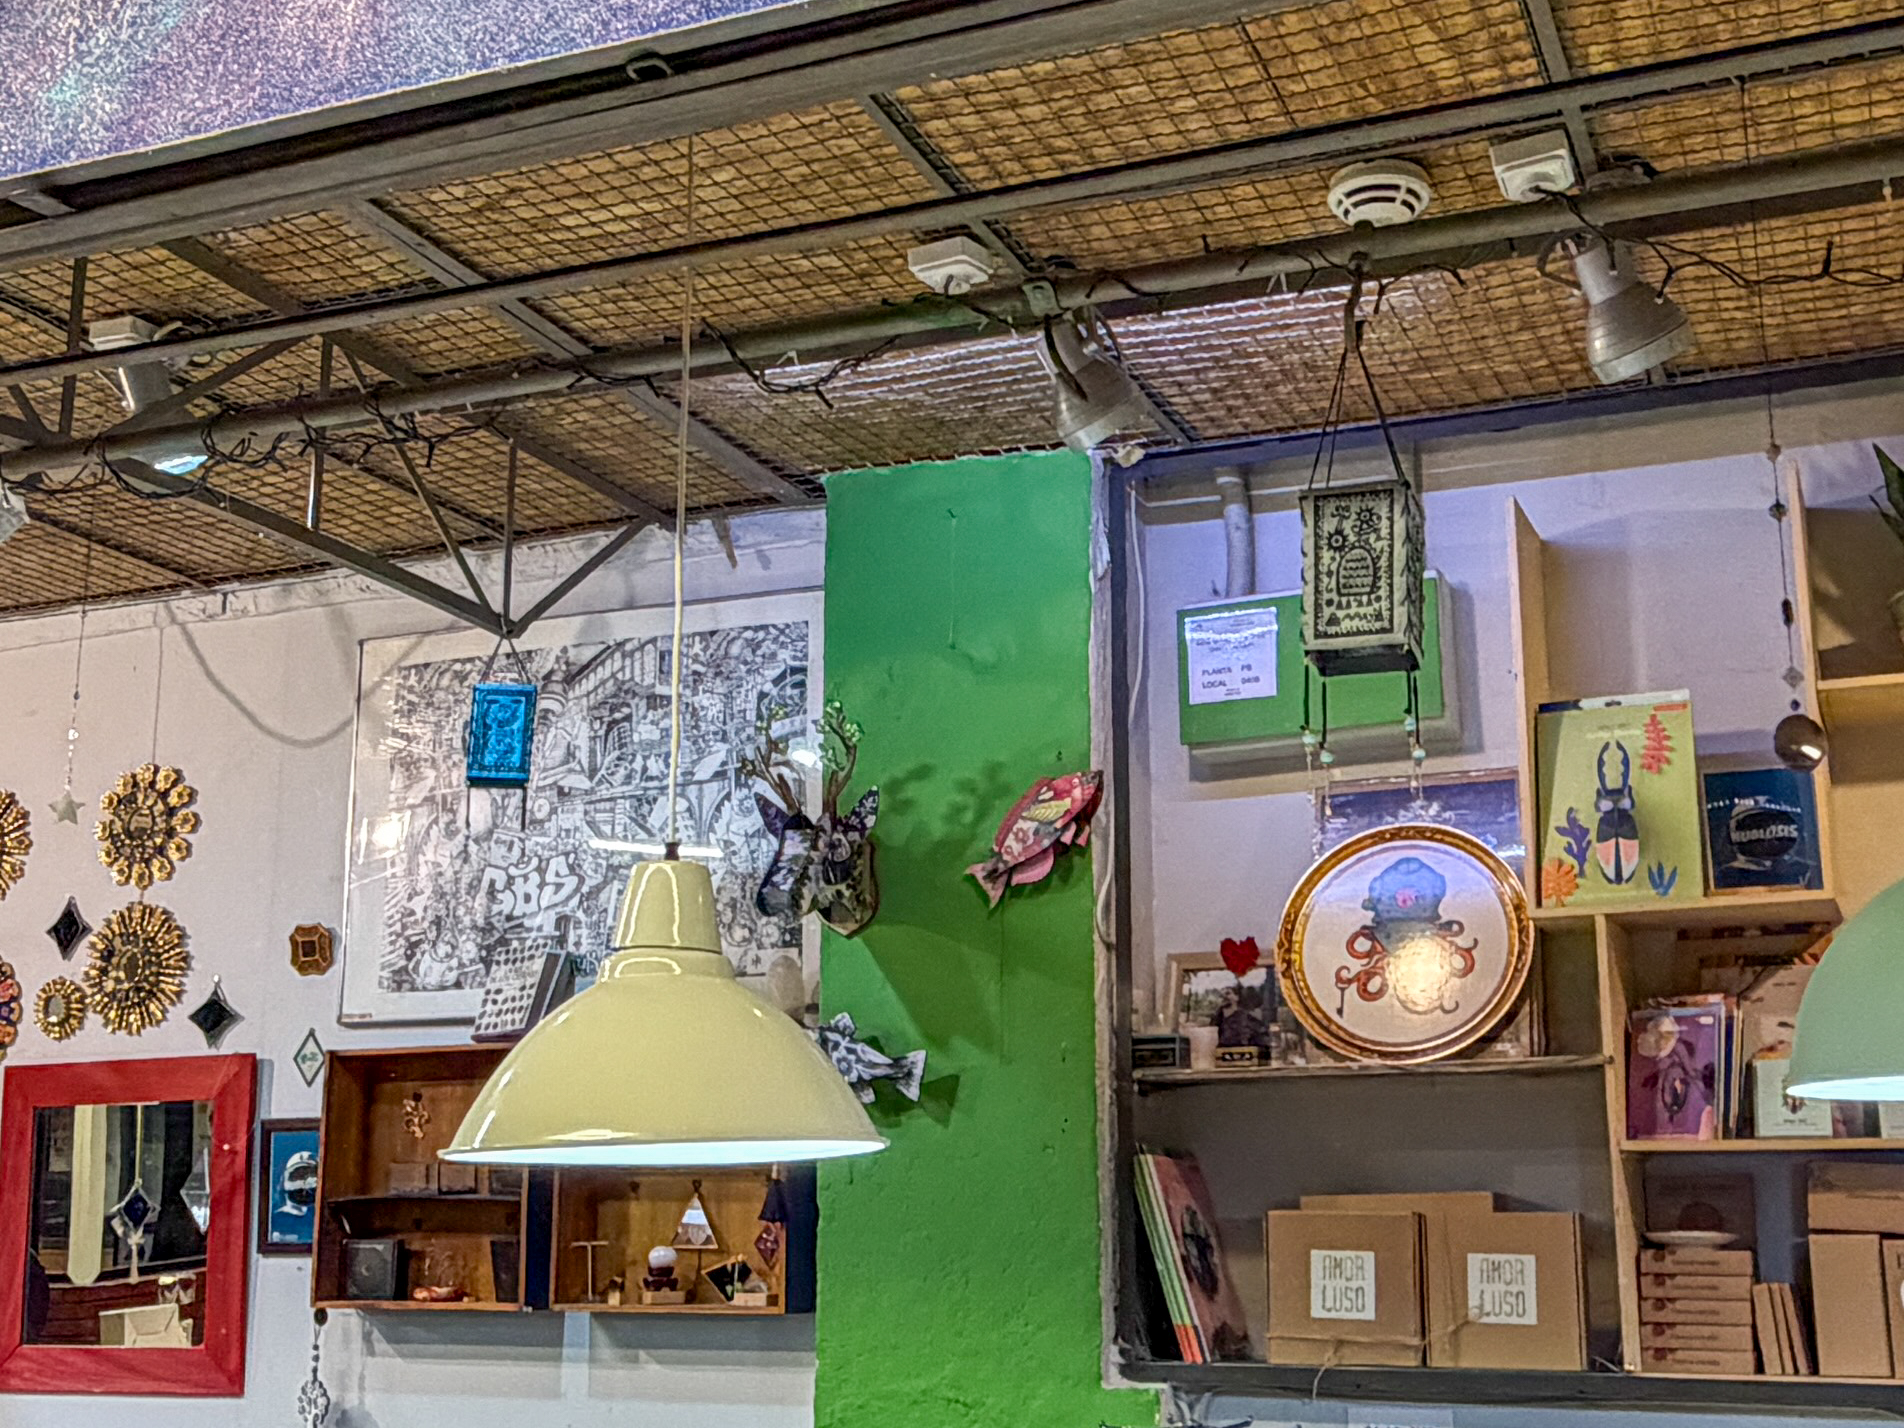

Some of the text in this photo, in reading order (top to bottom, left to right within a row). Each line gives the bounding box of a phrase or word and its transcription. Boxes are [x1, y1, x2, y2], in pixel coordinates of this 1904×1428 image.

[1201, 679, 1228, 689] LOCAL
[1322, 1254, 1367, 1282] AMOR
[1478, 1258, 1527, 1286] AMOR
[1321, 1286, 1366, 1314] LUSO
[1477, 1289, 1527, 1319] LUSO
